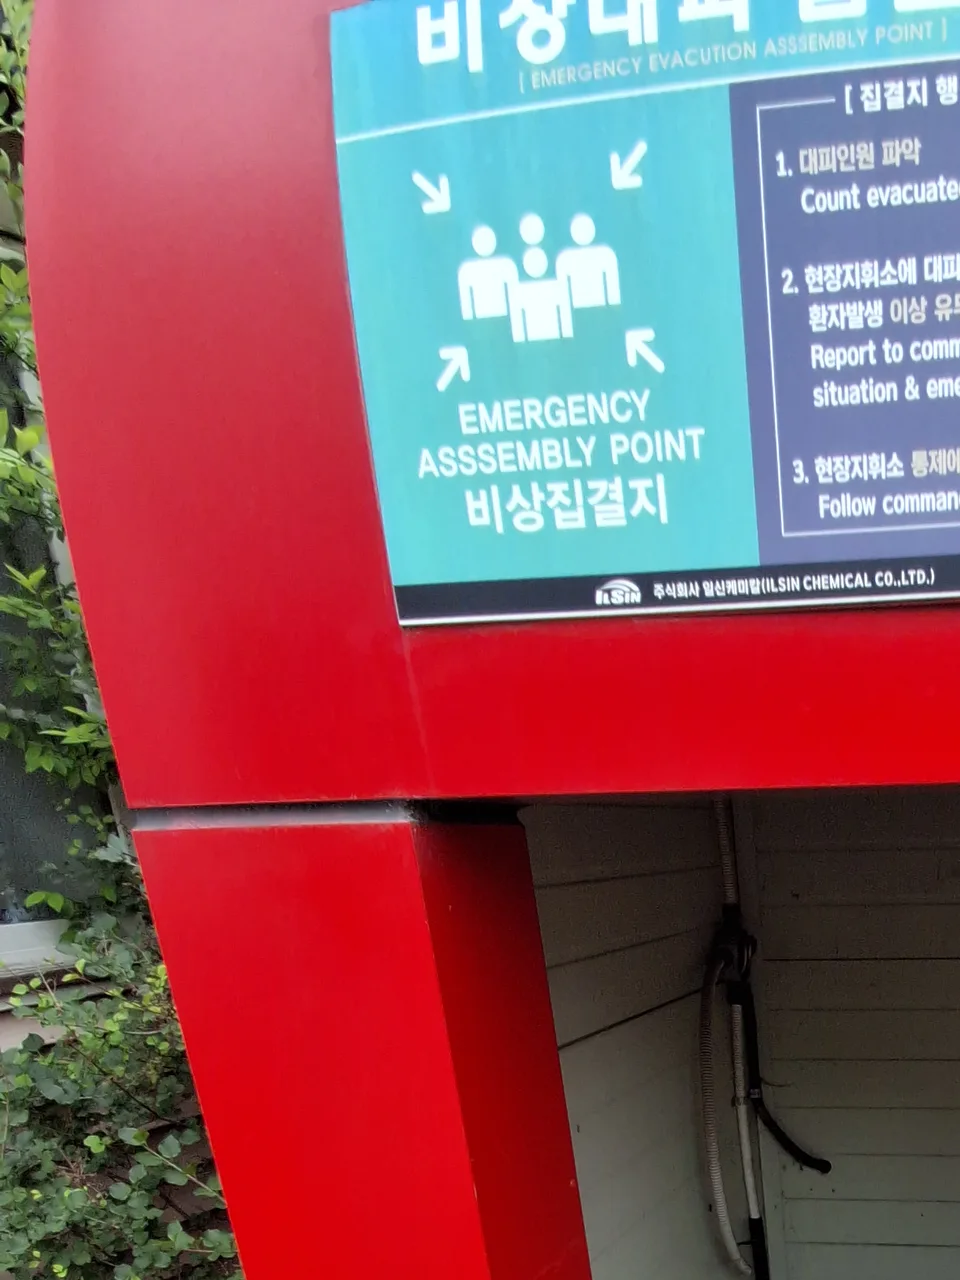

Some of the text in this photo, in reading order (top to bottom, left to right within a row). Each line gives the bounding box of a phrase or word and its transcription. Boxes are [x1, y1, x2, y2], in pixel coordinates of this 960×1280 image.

[531, 56, 641, 89] EMERGENCY
[649, 42, 757, 72] EVACUTION
[875, 21, 933, 45] POINT
[860, 77, 928, 112] 집결지
[776, 137, 922, 177] 1. 대피인원 파악
[801, 184, 861, 214] Count
[781, 268, 799, 295] 2.
[804, 257, 917, 295] 현장지휘소에
[924, 253, 960, 284] 대피
[808, 299, 883, 332] 환자발생
[890, 295, 928, 324] 이상
[811, 338, 877, 370] Report
[883, 337, 903, 363] to
[813, 374, 898, 408] situation
[904, 375, 920, 401] &
[458, 388, 651, 435] EMERGENCY
[418, 427, 706, 479] ASSSEMBLY POINT
[792, 459, 809, 484] 3.
[814, 452, 904, 484] 현장지휘소
[464, 473, 669, 534] 비상집결지
[818, 491, 876, 519] Follow
[653, 579, 700, 600] 주식회사
[803, 570, 872, 592] CHEMICAL
